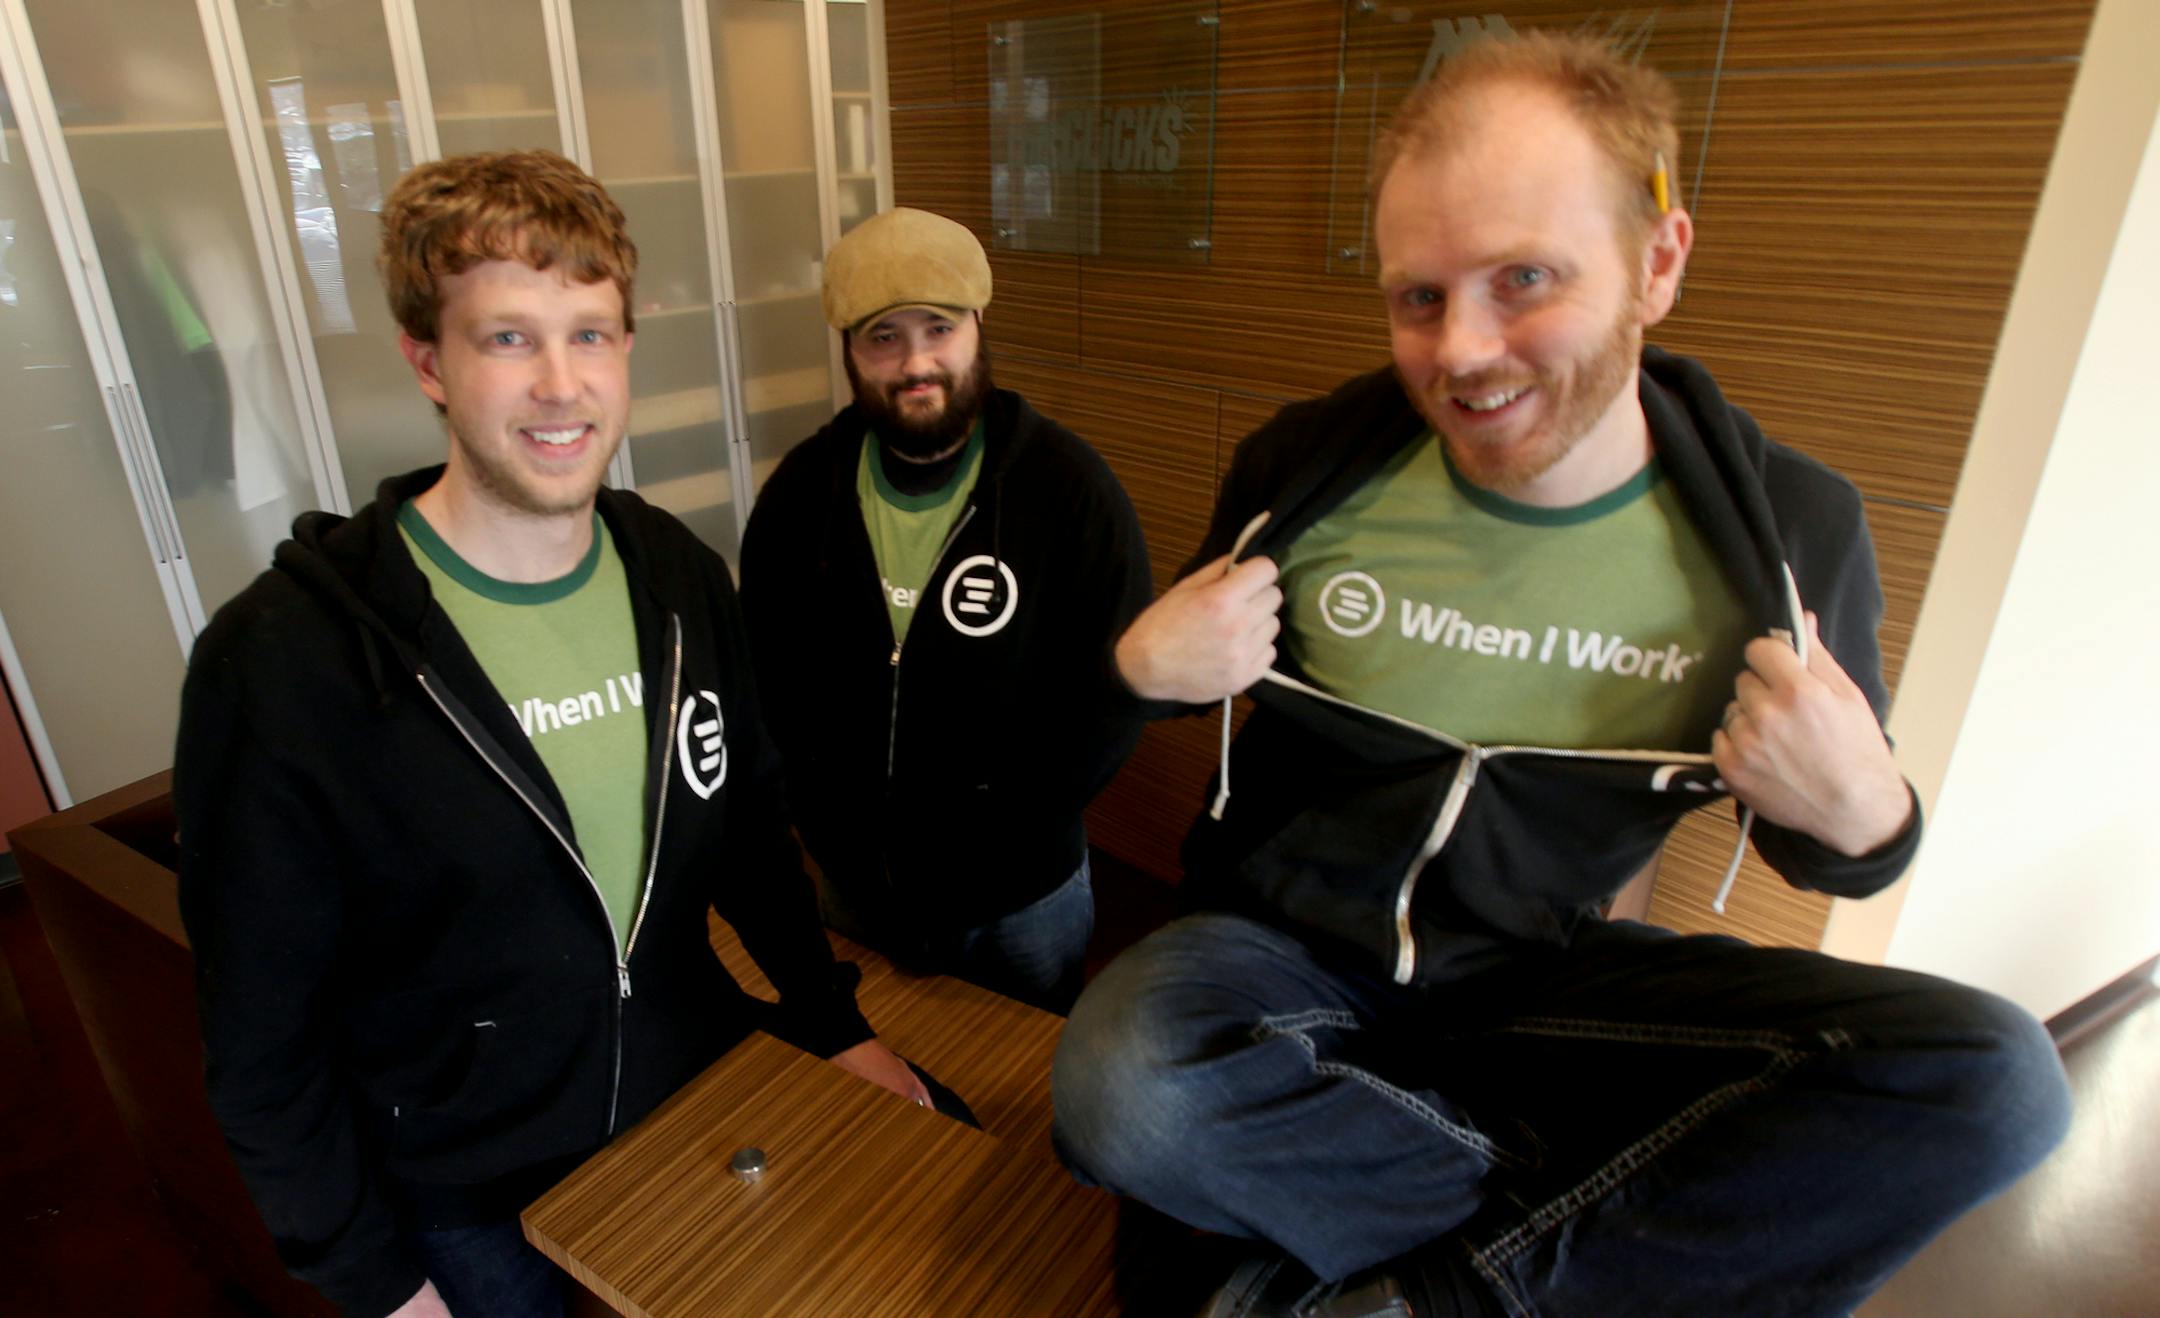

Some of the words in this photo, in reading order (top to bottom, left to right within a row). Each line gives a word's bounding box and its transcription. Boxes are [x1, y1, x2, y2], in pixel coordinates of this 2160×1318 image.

[1401, 598, 1532, 660] When
[1539, 625, 1559, 664] I
[1567, 628, 1694, 683] Work
[605, 677, 621, 713] I
